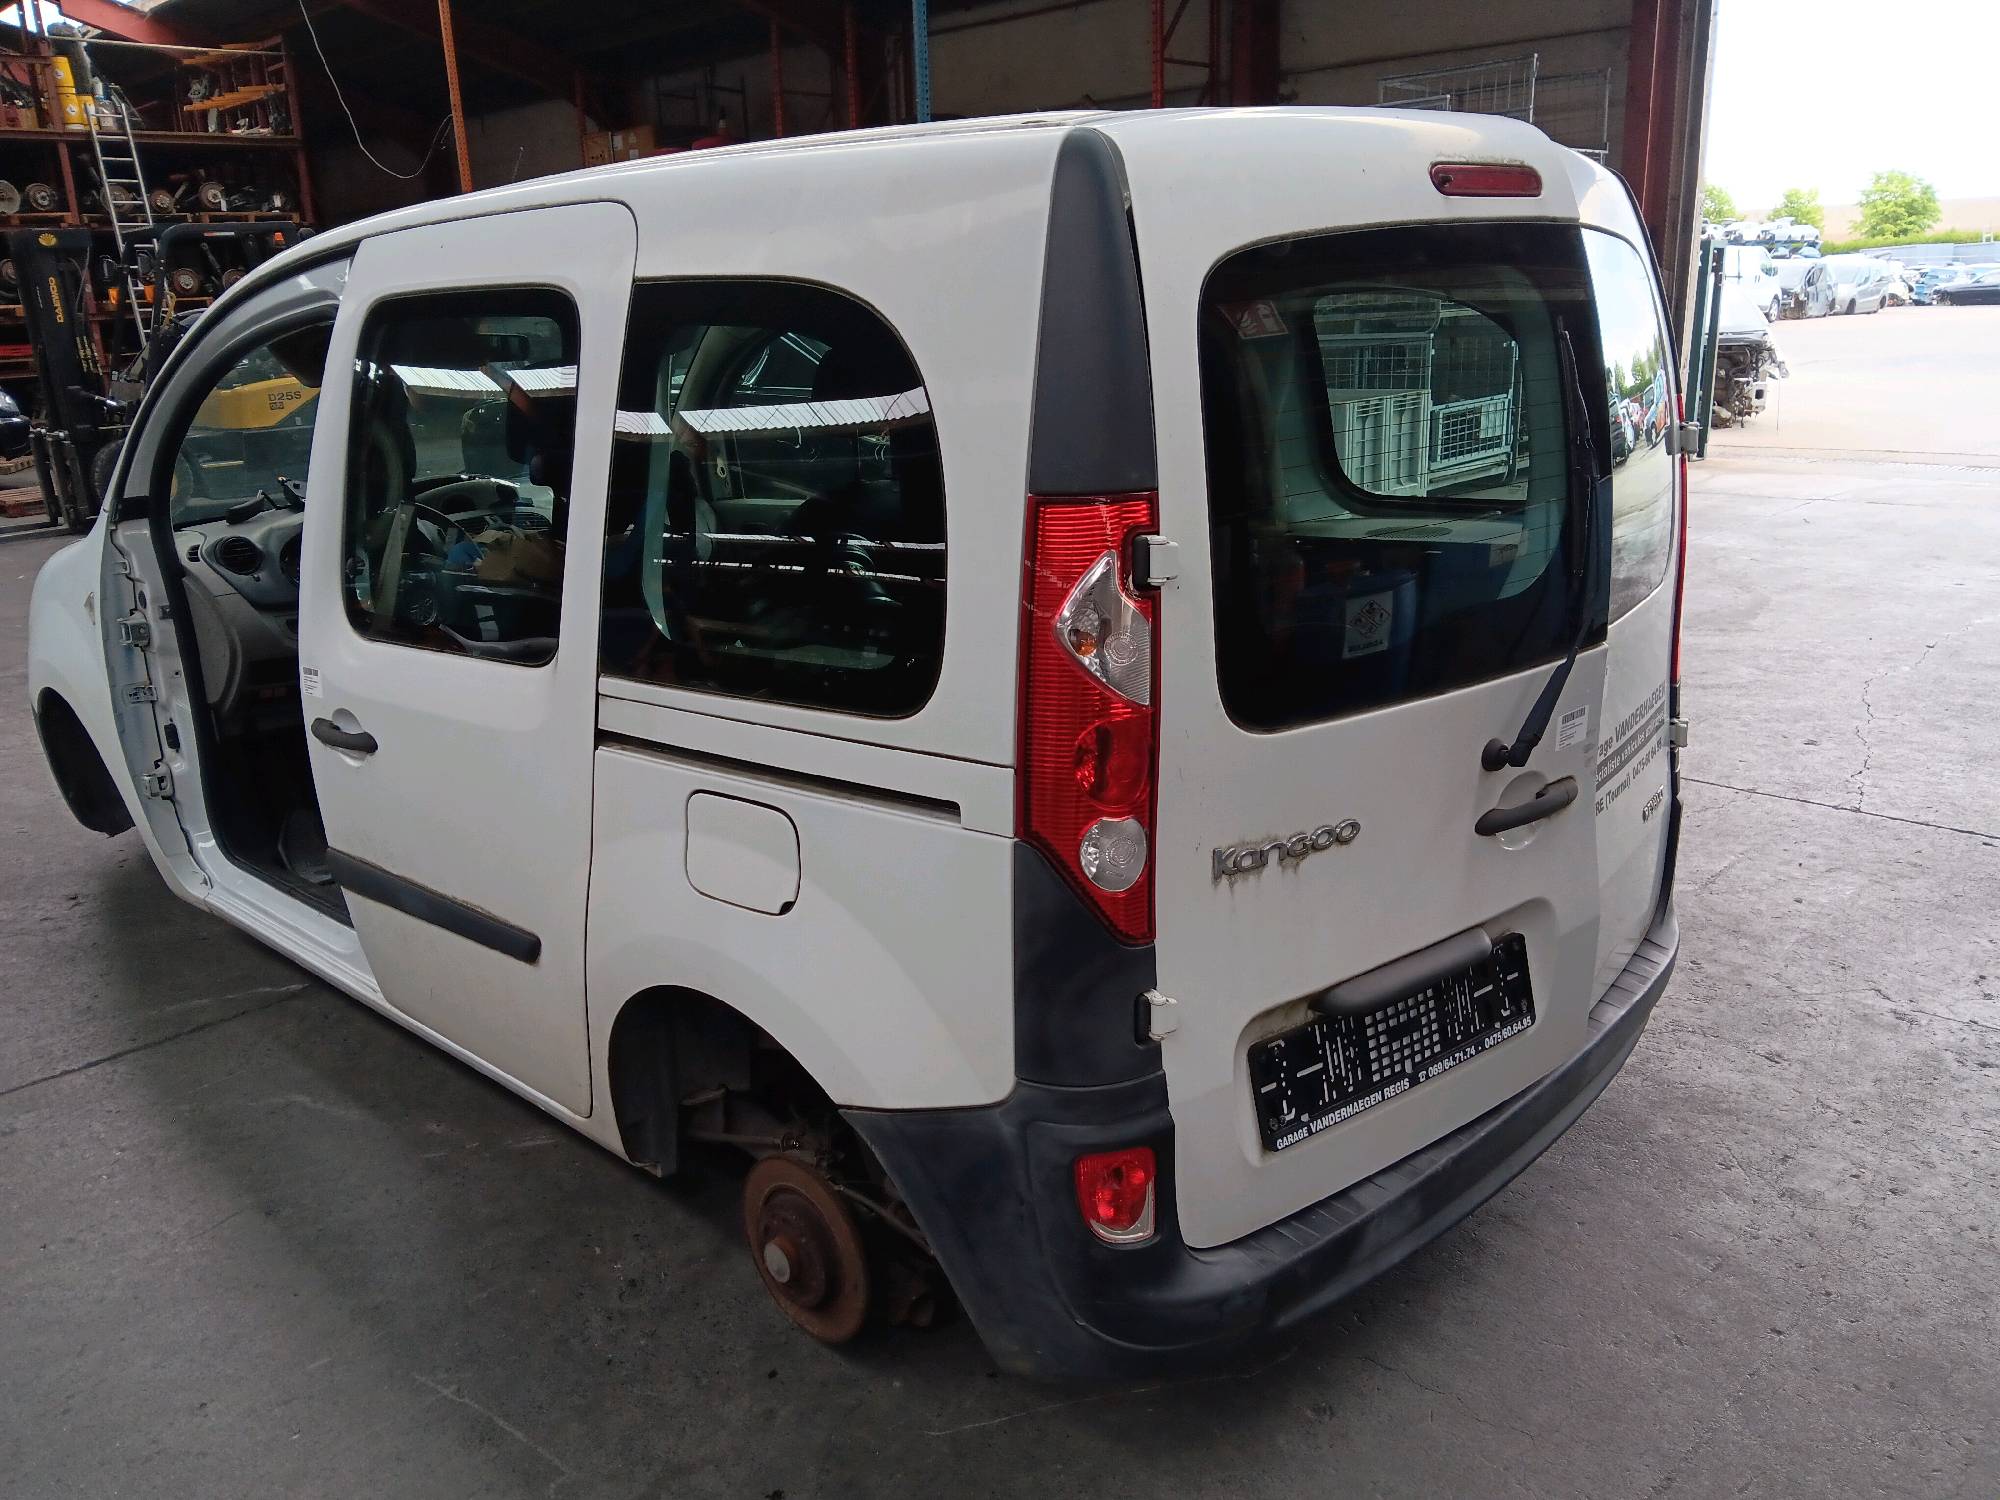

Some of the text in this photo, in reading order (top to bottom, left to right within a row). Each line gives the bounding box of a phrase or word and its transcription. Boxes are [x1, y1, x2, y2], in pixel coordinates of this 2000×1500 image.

[48, 276, 64, 323] DAEWOO
[268, 391, 302, 401] D25S
[1276, 1127, 1309, 1149] GARAGE
[1309, 1091, 1382, 1133] VANDERHAEGEN
[1383, 1078, 1410, 1099] REGIS
